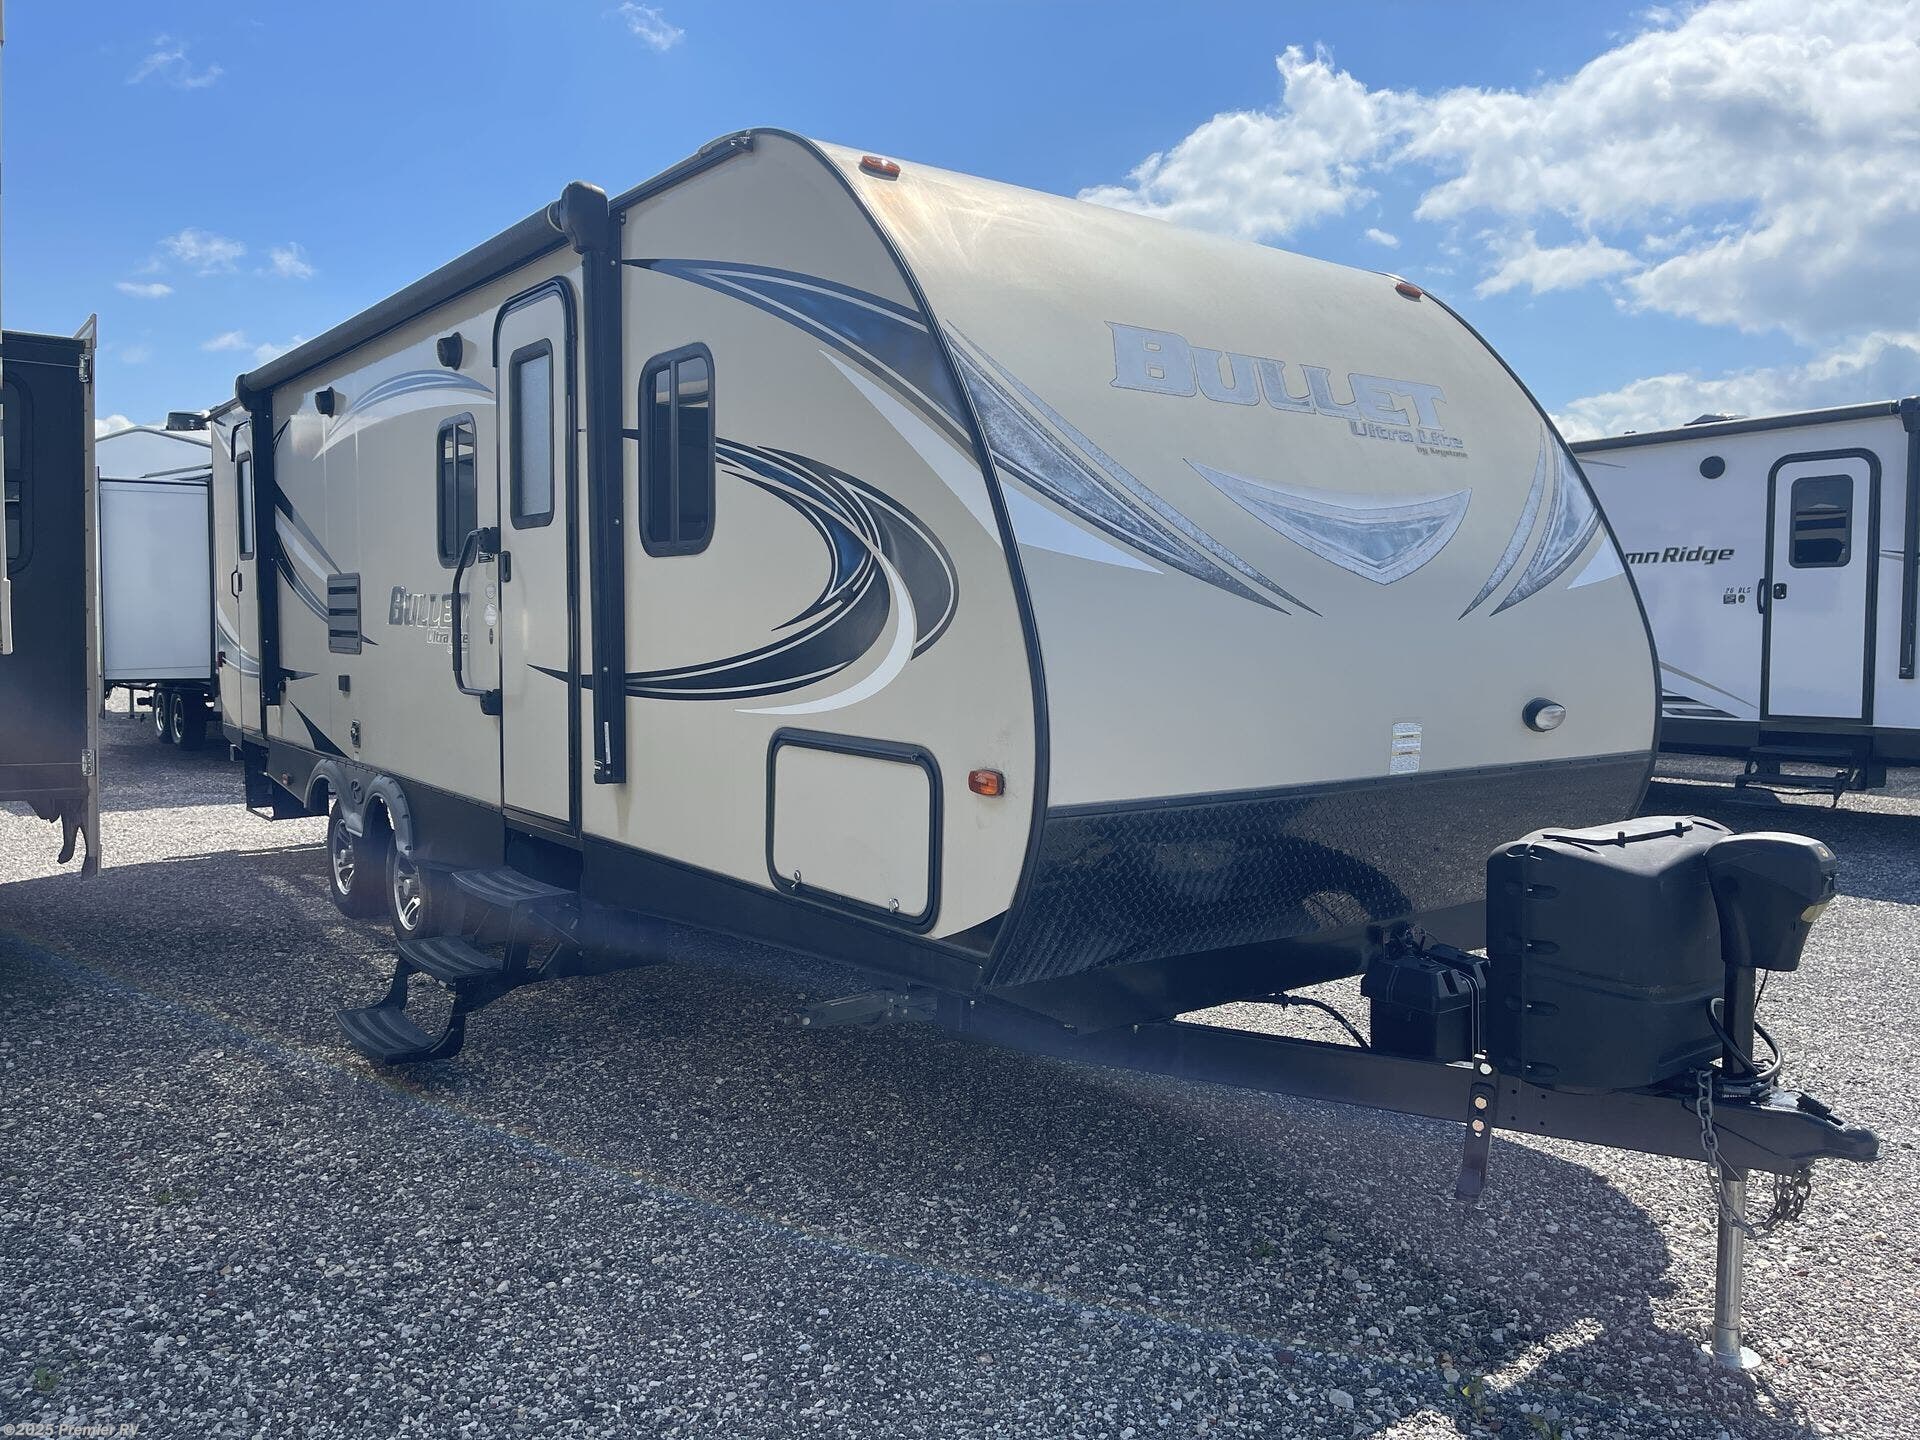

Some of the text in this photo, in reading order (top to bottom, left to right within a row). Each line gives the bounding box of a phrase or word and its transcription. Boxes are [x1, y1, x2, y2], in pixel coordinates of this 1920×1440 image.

[1104, 321, 1447, 431] BULLET
[1349, 421, 1464, 449] Ultra Lite
[1662, 546, 1735, 566] Ridge
[426, 628, 450, 643] Ultra
